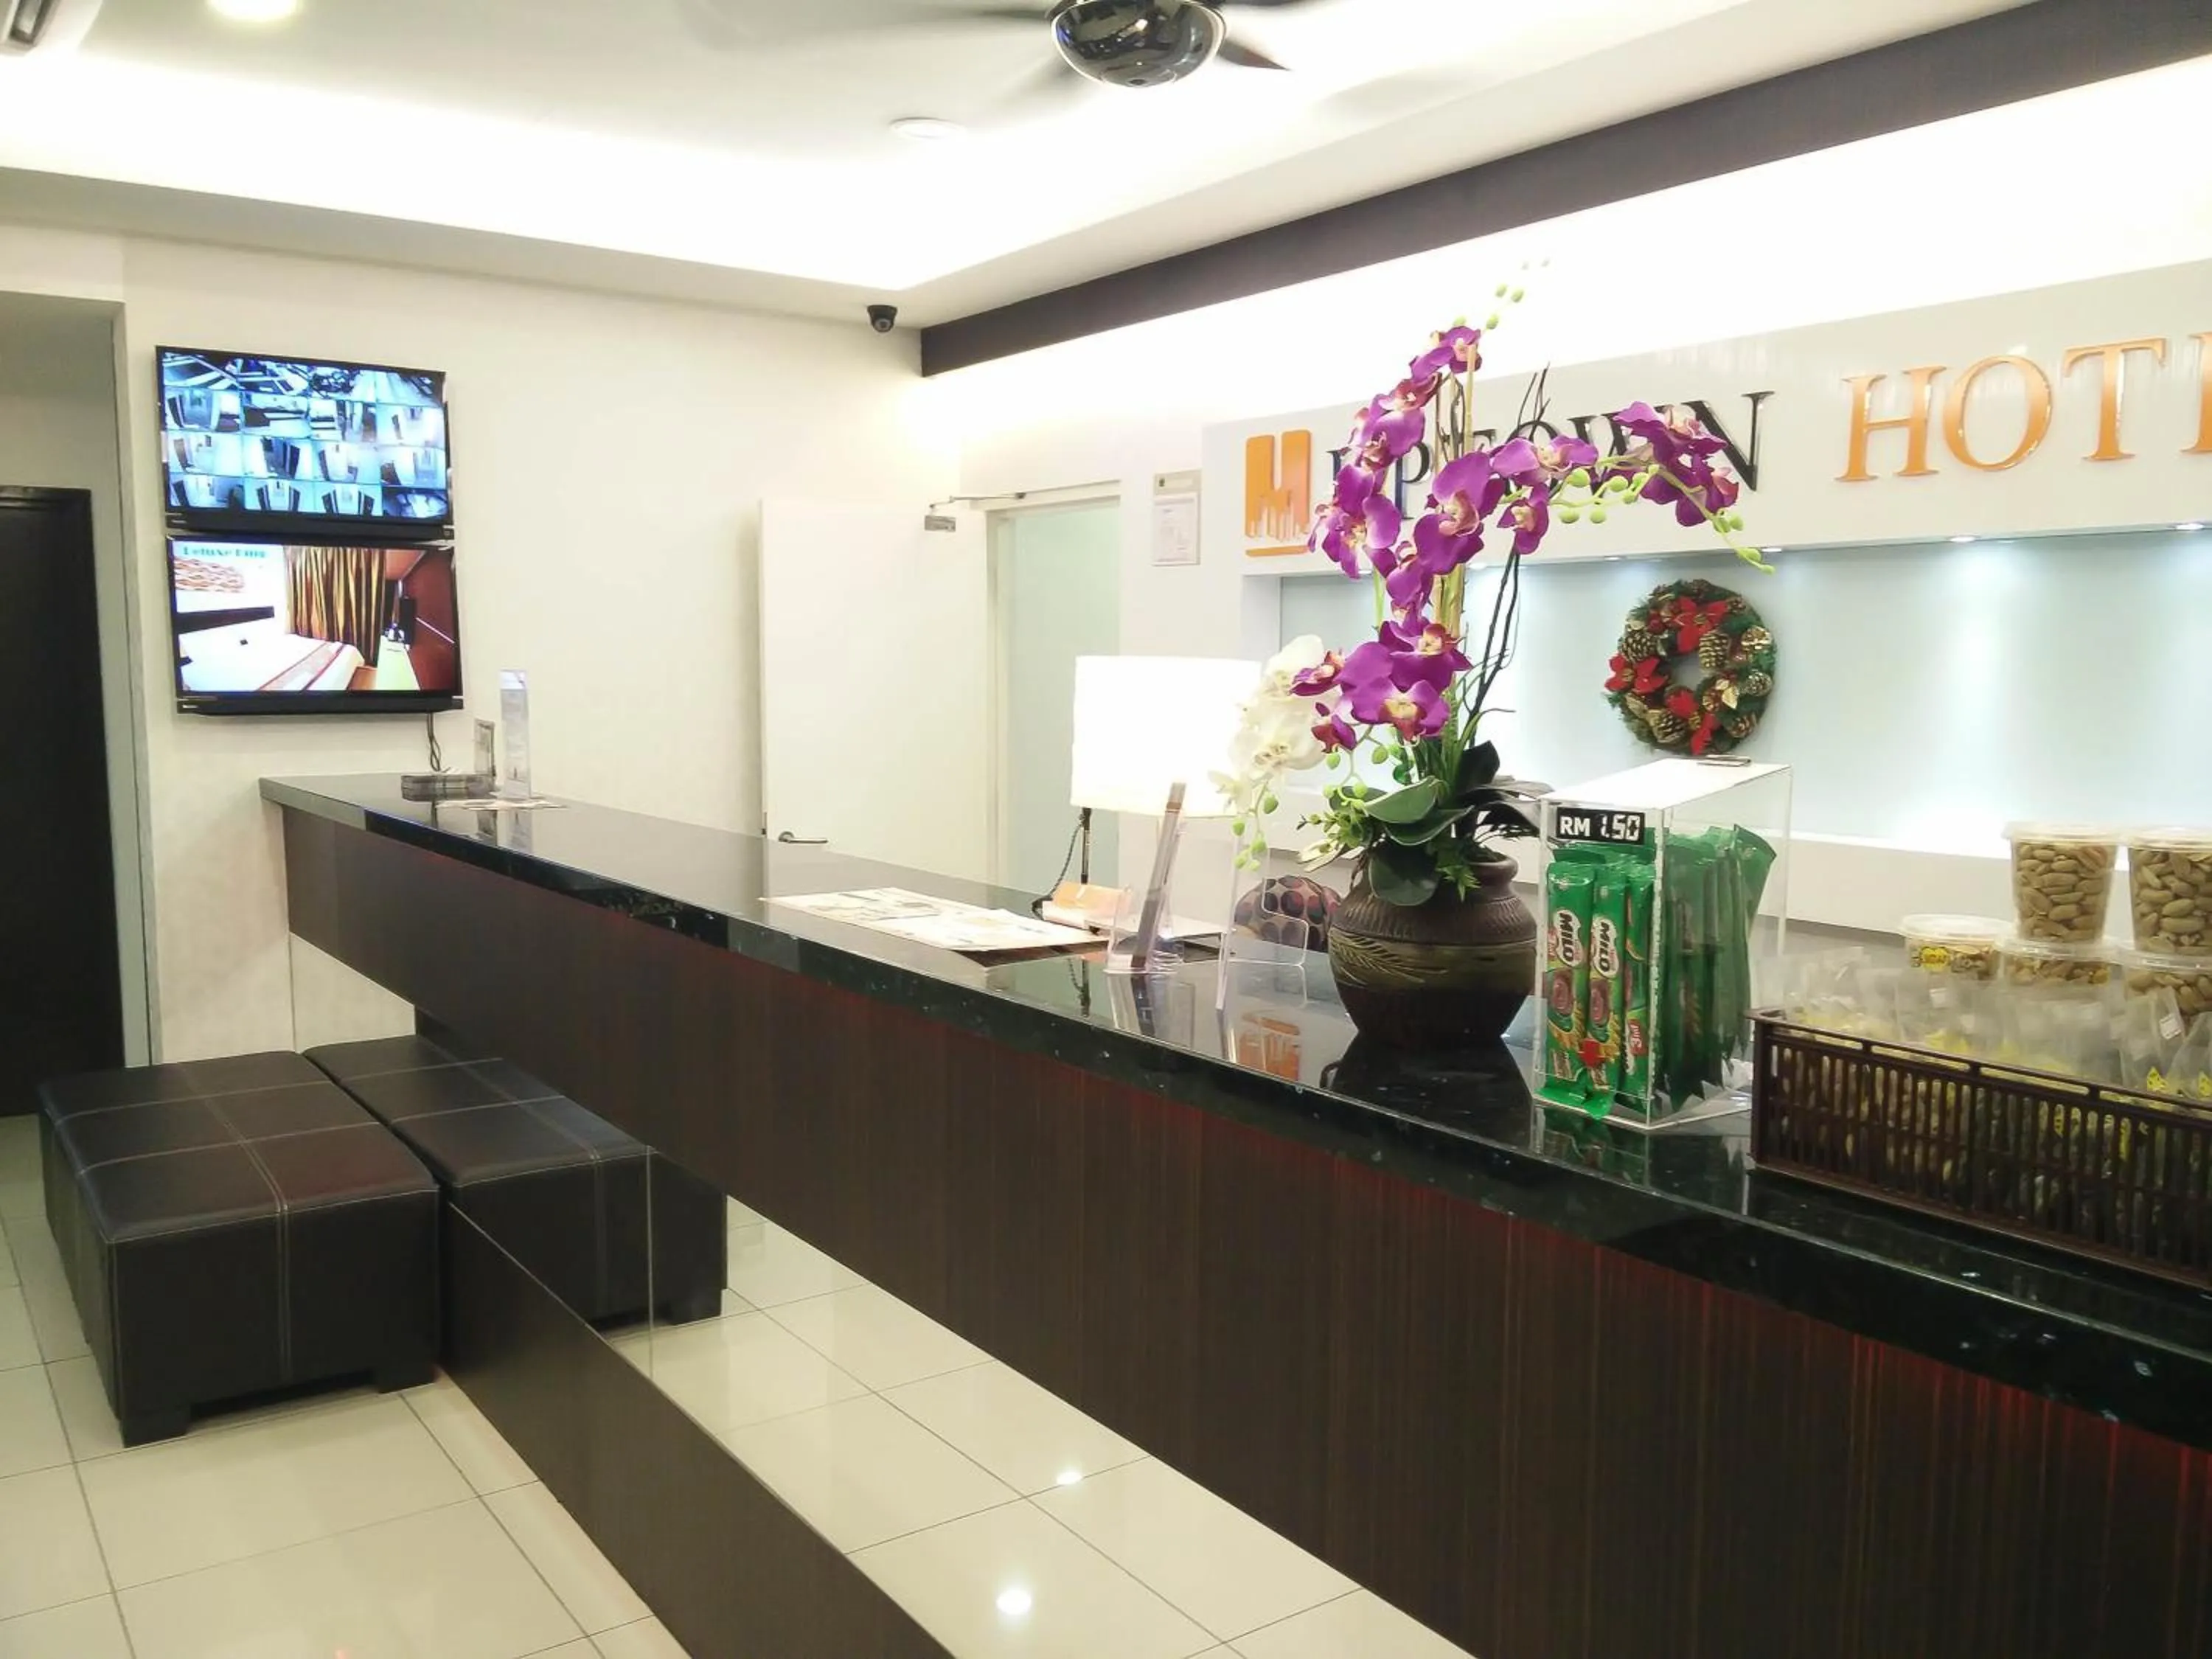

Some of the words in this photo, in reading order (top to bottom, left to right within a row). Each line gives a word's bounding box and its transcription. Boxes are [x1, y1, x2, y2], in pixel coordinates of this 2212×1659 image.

[1834, 330, 2212, 483] HOT
[1559, 815, 1590, 837] RM
[1600, 813, 1641, 841] 1.50
[1559, 912, 1574, 962] MILO
[1599, 921, 1610, 973] MILO
